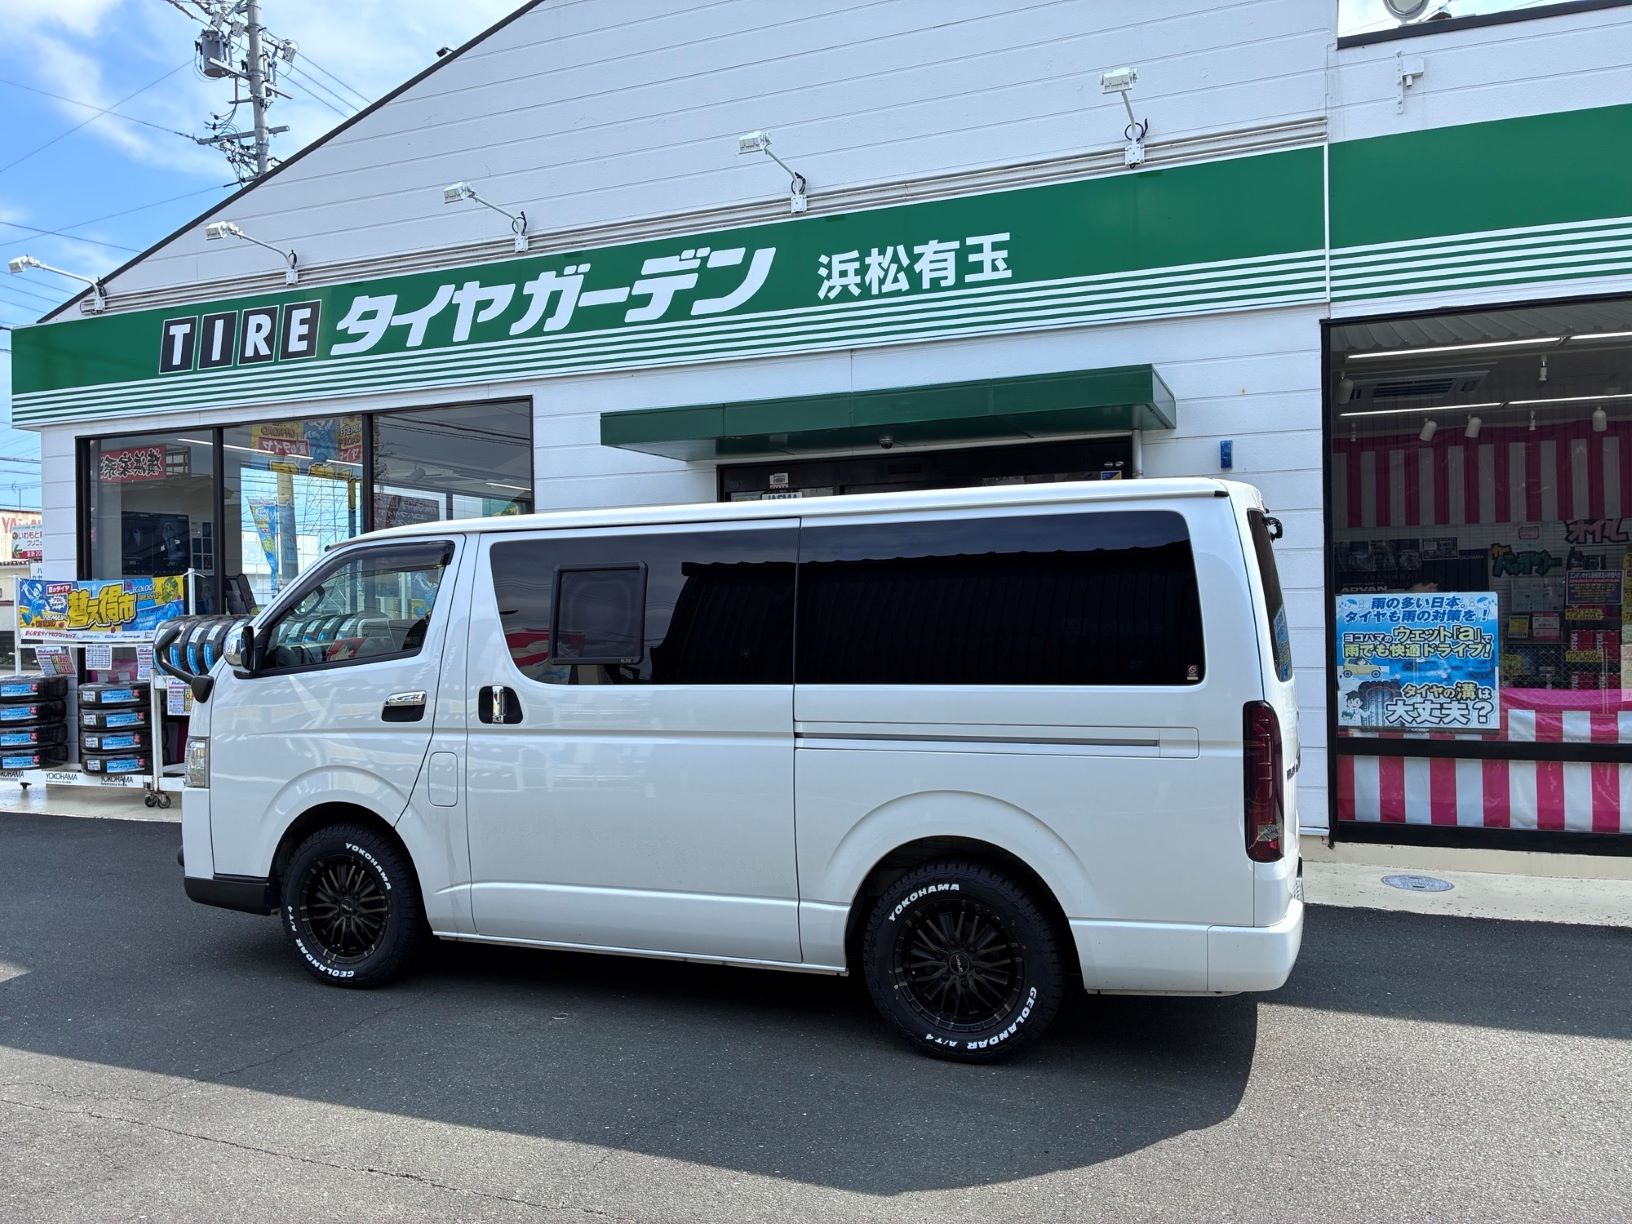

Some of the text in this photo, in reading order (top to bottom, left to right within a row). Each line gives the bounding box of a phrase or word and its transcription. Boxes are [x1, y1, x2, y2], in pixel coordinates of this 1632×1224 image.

[167, 232, 1012, 367] TIRE タイヤガーデン 浜松有玉
[1371, 597, 1466, 610] 雨の多い日本。
[1345, 610, 1488, 623] タイヤも雨の対策を！
[1344, 644, 1491, 658] 雨でも快適ドライブ！
[1403, 682, 1492, 700] タイヤの溝は
[1386, 700, 1494, 725] 大丈夫？
[46, 772, 78, 781] YOKOHAMA
[345, 842, 392, 891] YOKOHAMA
[889, 883, 960, 922] YOKOHAMA
[296, 938, 355, 978] GEOLANDAR
[966, 986, 1038, 1050] GEOLANDAR
